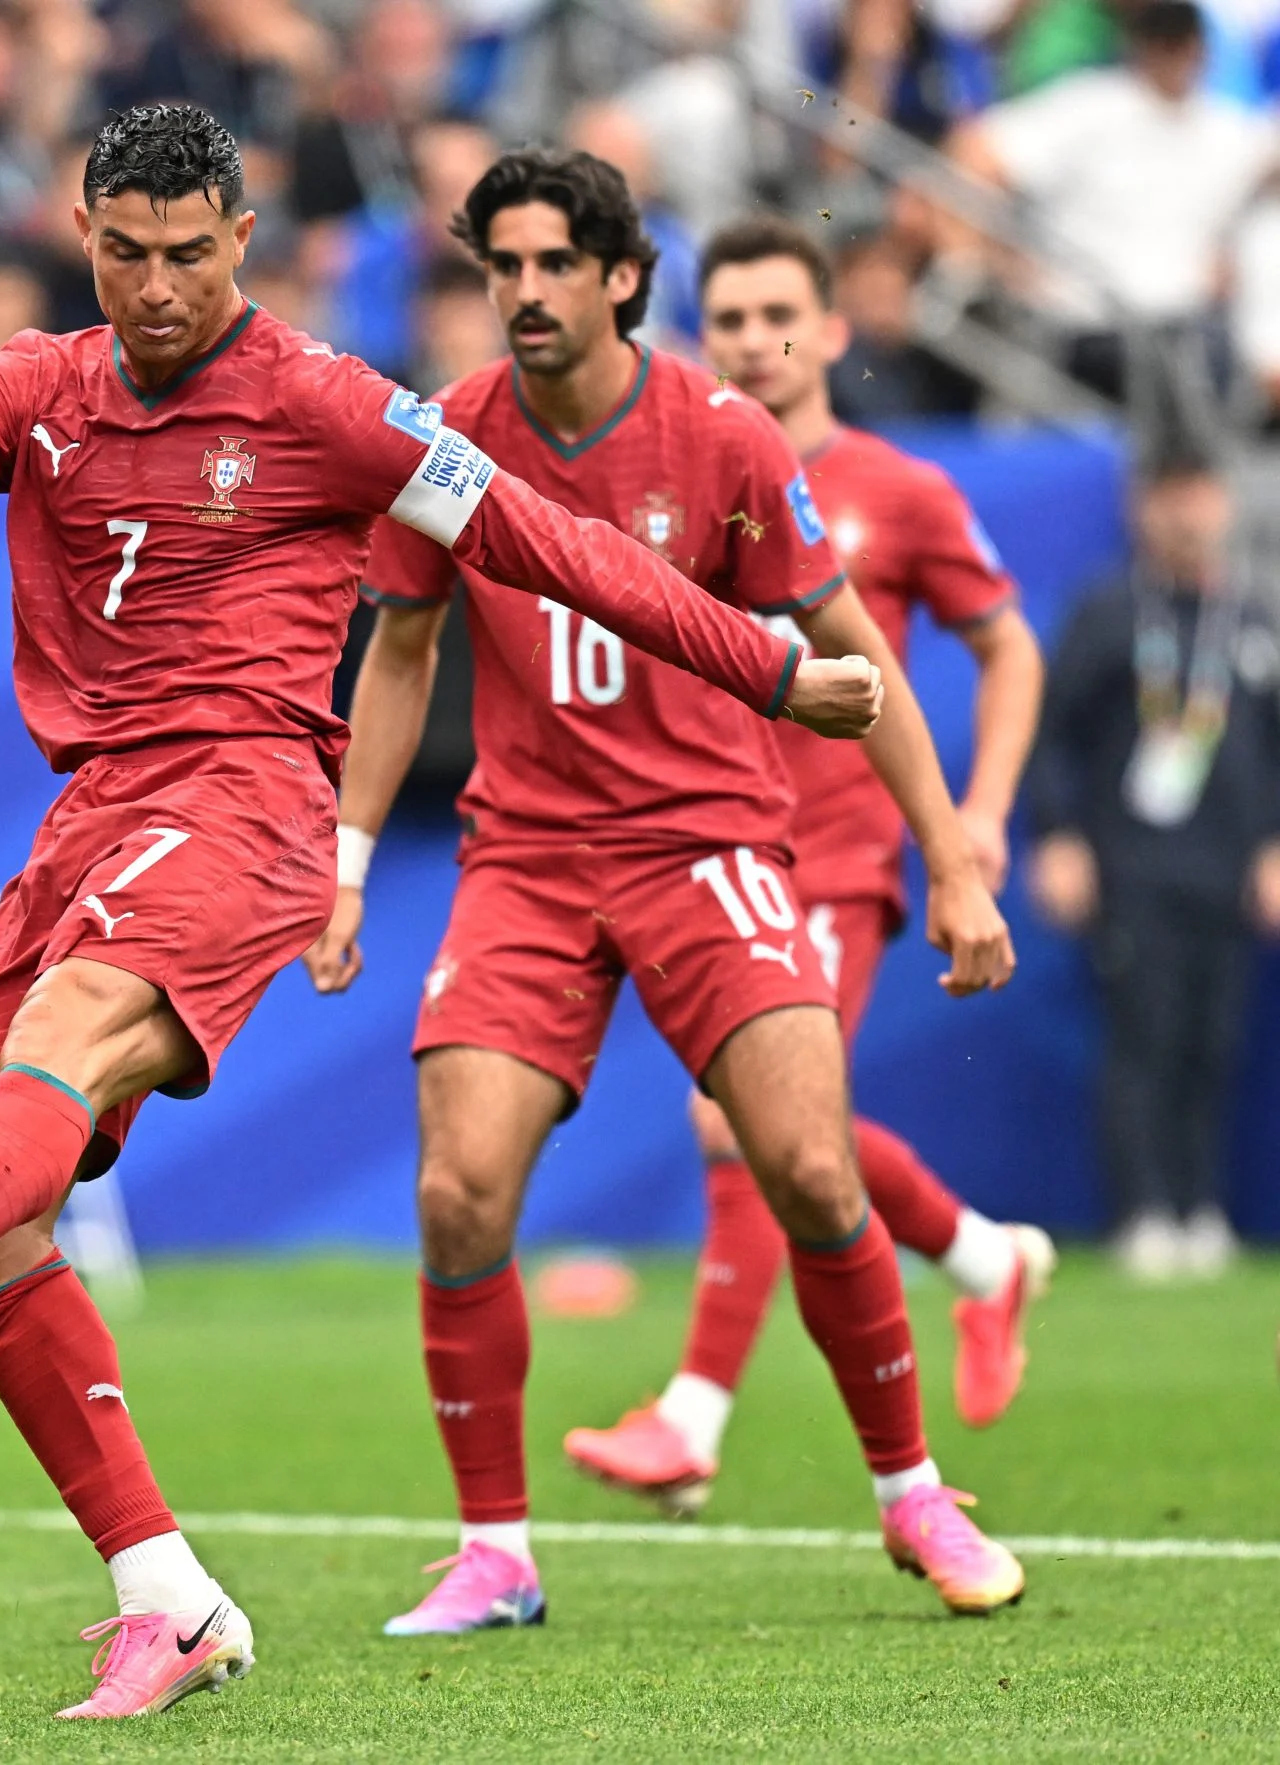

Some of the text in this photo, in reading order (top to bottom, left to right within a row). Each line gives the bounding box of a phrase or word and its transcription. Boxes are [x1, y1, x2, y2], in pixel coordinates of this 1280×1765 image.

[198, 515, 233, 523] HOUSTON
[451, 475, 470, 498] the
[103, 520, 147, 620] 7
[537, 595, 626, 706] 16
[102, 827, 192, 894] 7
[689, 846, 797, 940] 16
